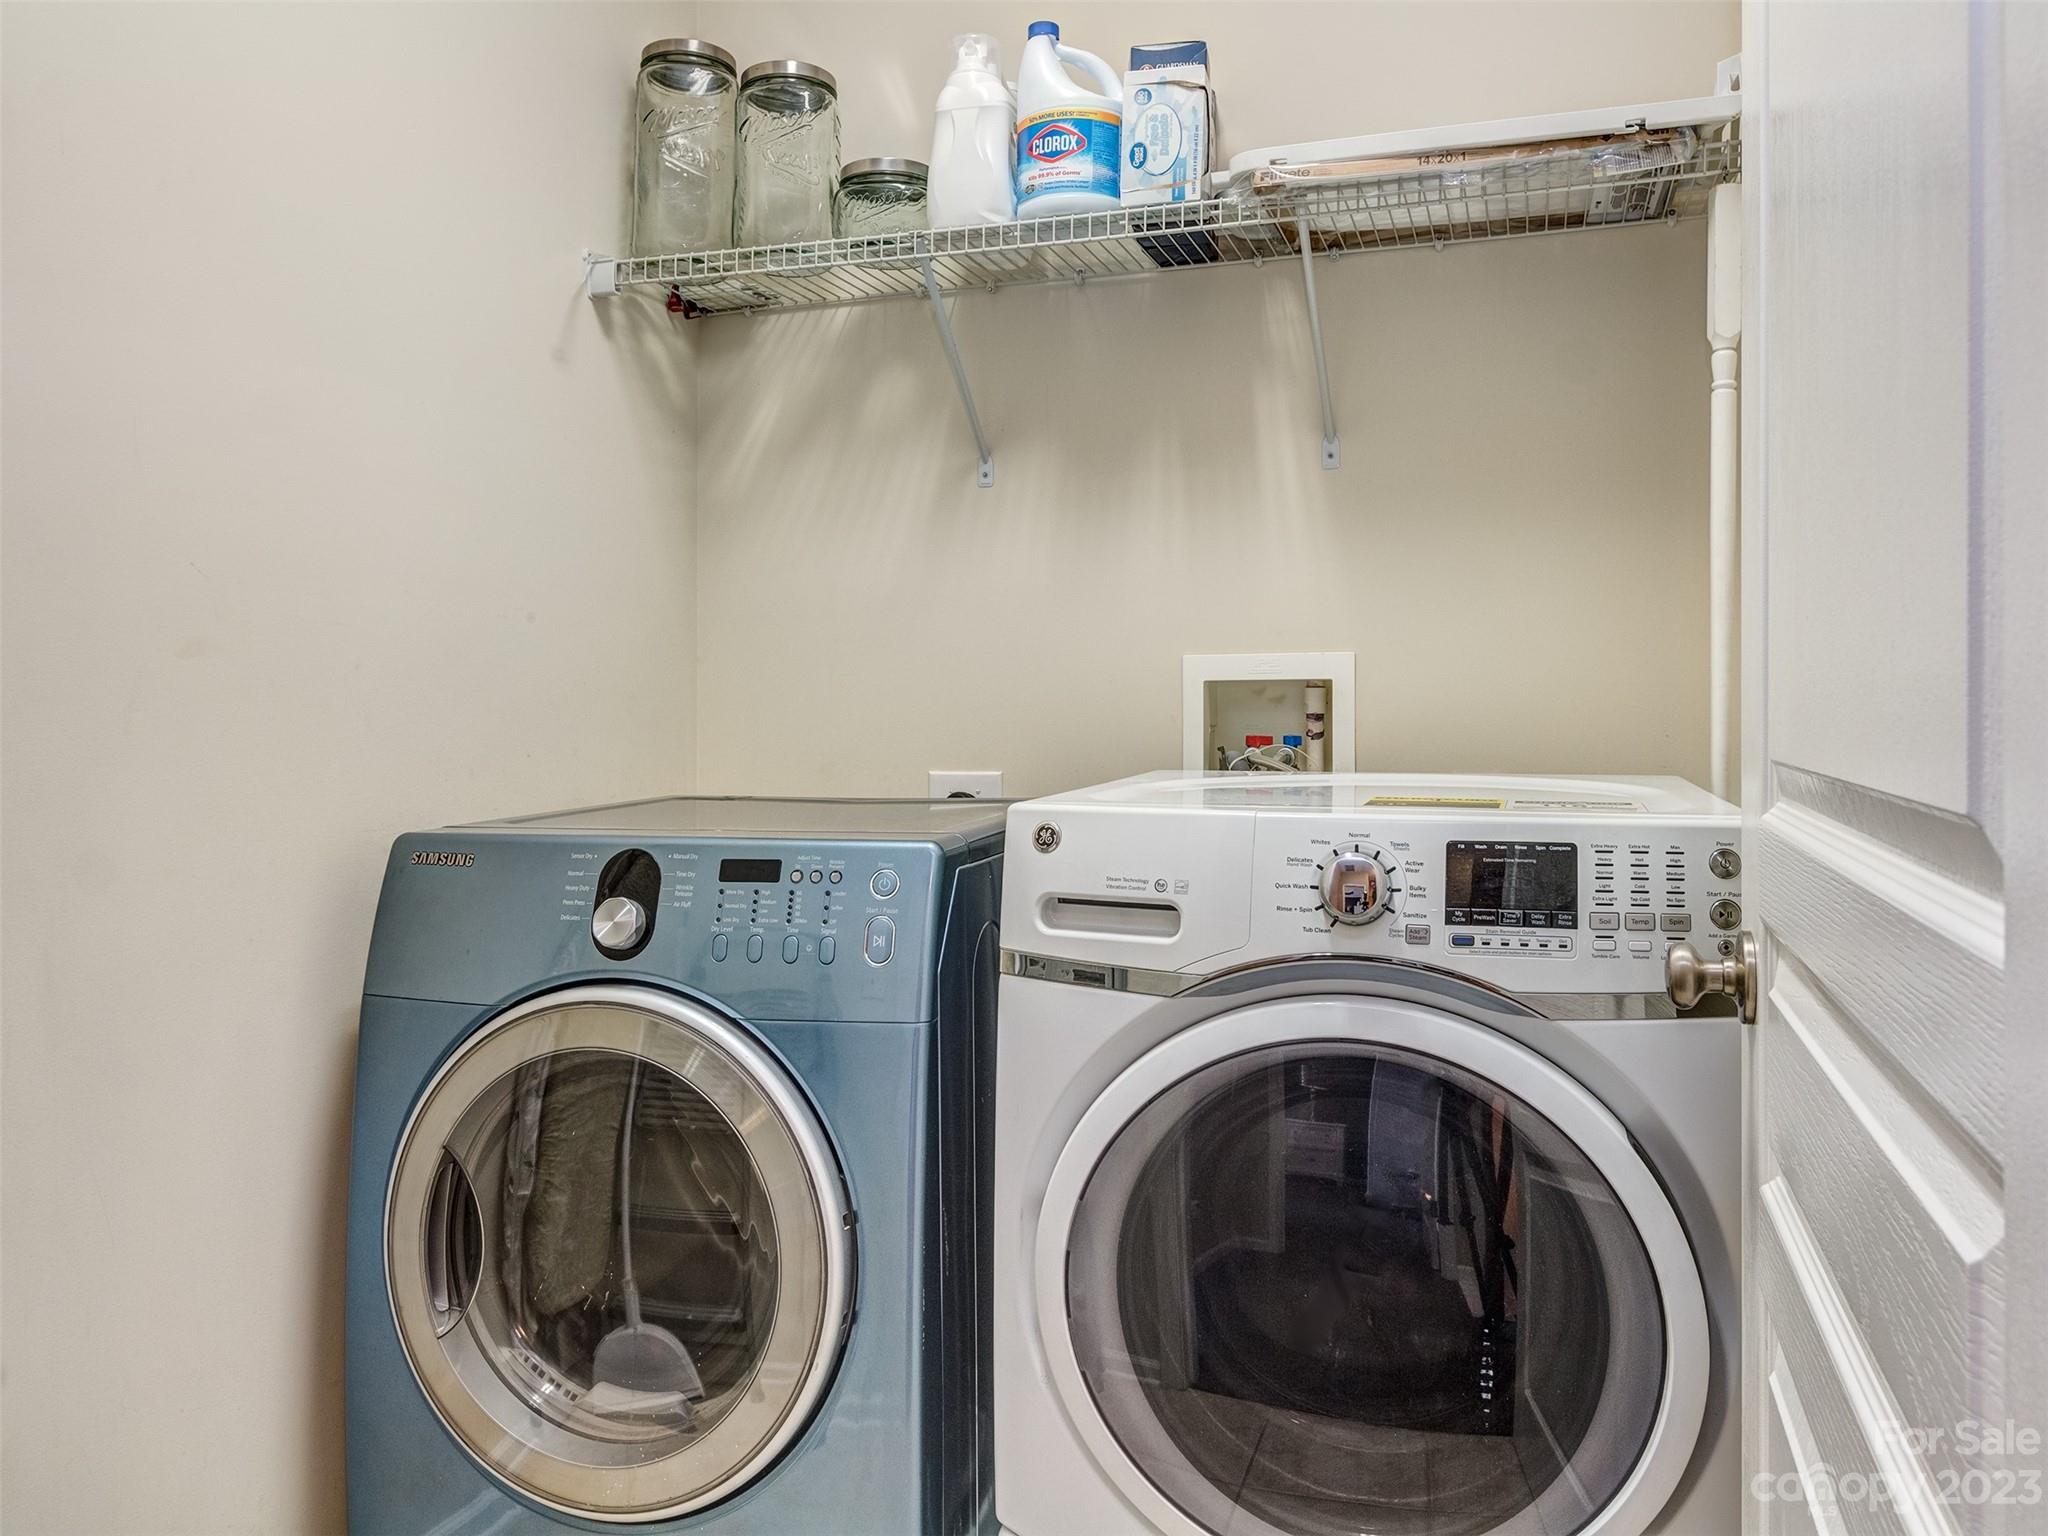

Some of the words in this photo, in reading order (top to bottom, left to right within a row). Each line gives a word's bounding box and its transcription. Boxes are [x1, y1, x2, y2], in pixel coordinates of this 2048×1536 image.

[1038, 112, 1055, 120] MORE
[1033, 135, 1078, 155] CLOROX
[1417, 151, 1466, 166] 14x20x1
[411, 851, 476, 867] SAMSUNG
[1122, 876, 1149, 885] Technology
[820, 927, 837, 935] Signal
